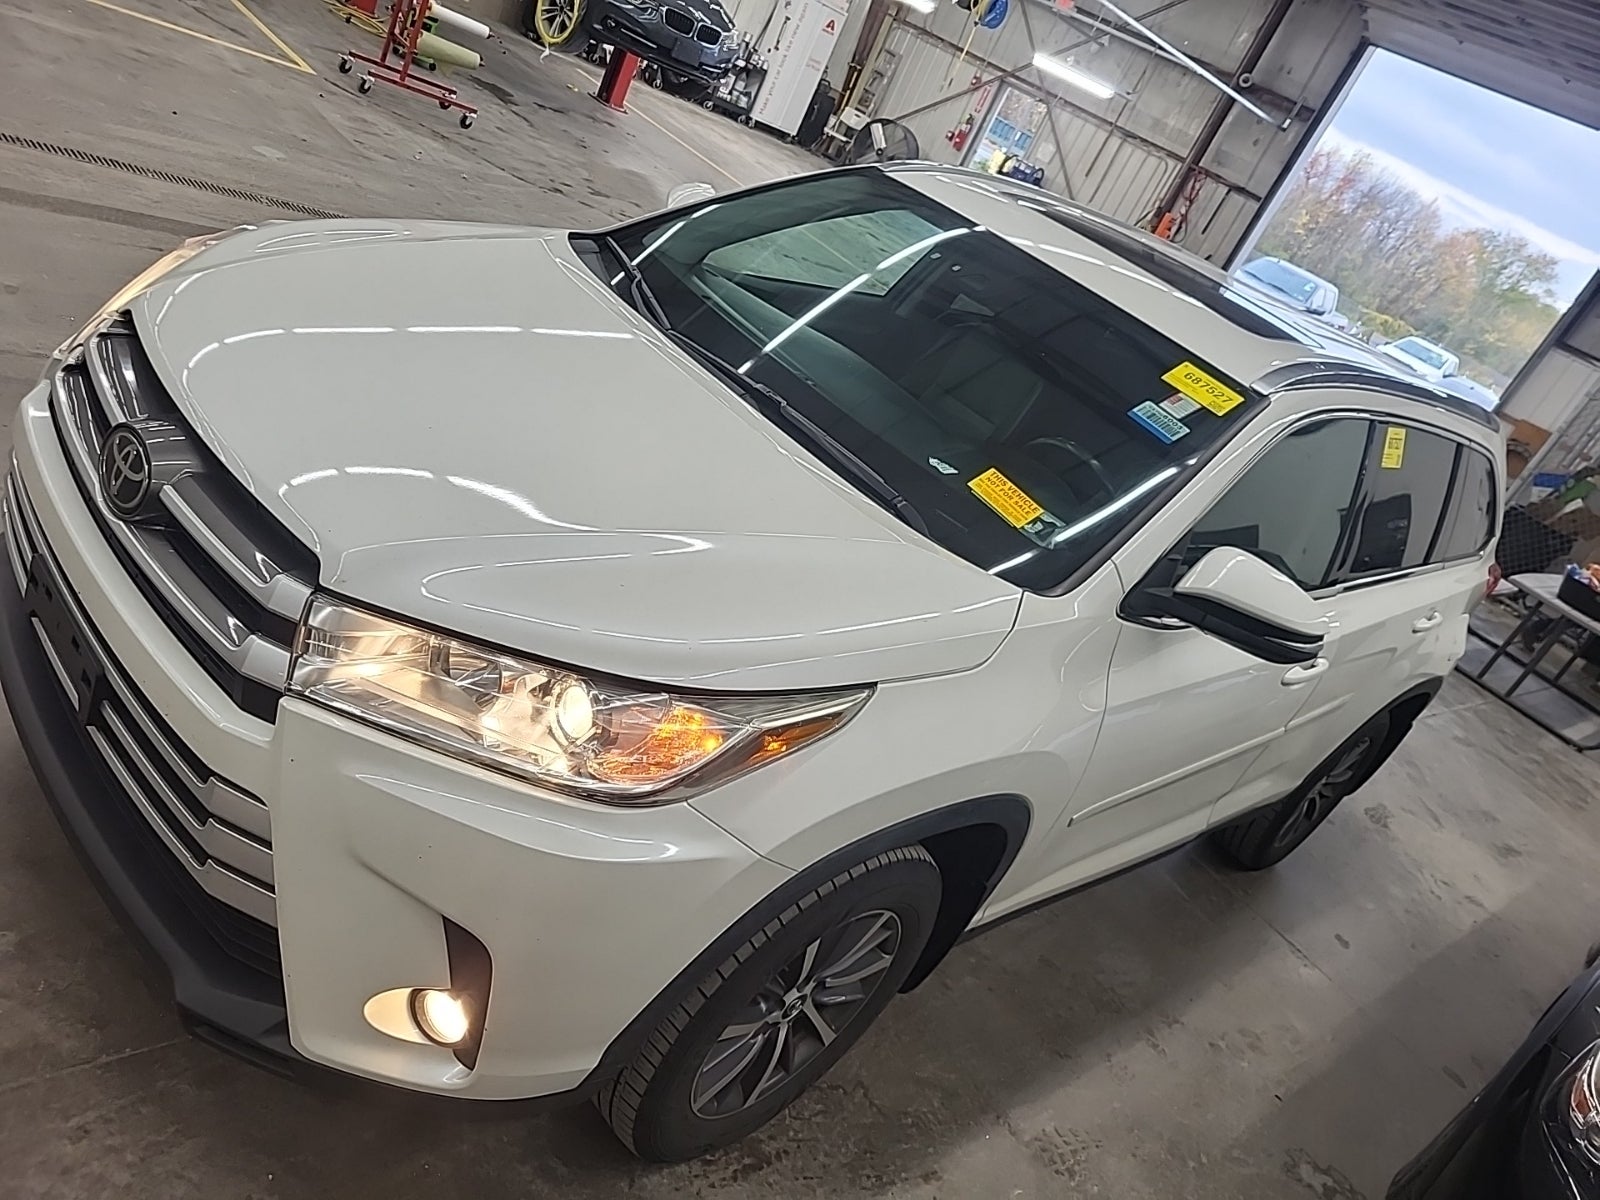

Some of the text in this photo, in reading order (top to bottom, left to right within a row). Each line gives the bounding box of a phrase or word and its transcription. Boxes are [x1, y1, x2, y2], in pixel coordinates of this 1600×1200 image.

[1183, 372, 1233, 404] 687527
[985, 476, 1032, 516] NOT FOR SALE
[990, 471, 1008, 487] THIS
[1008, 486, 1040, 514] VEHICLE
